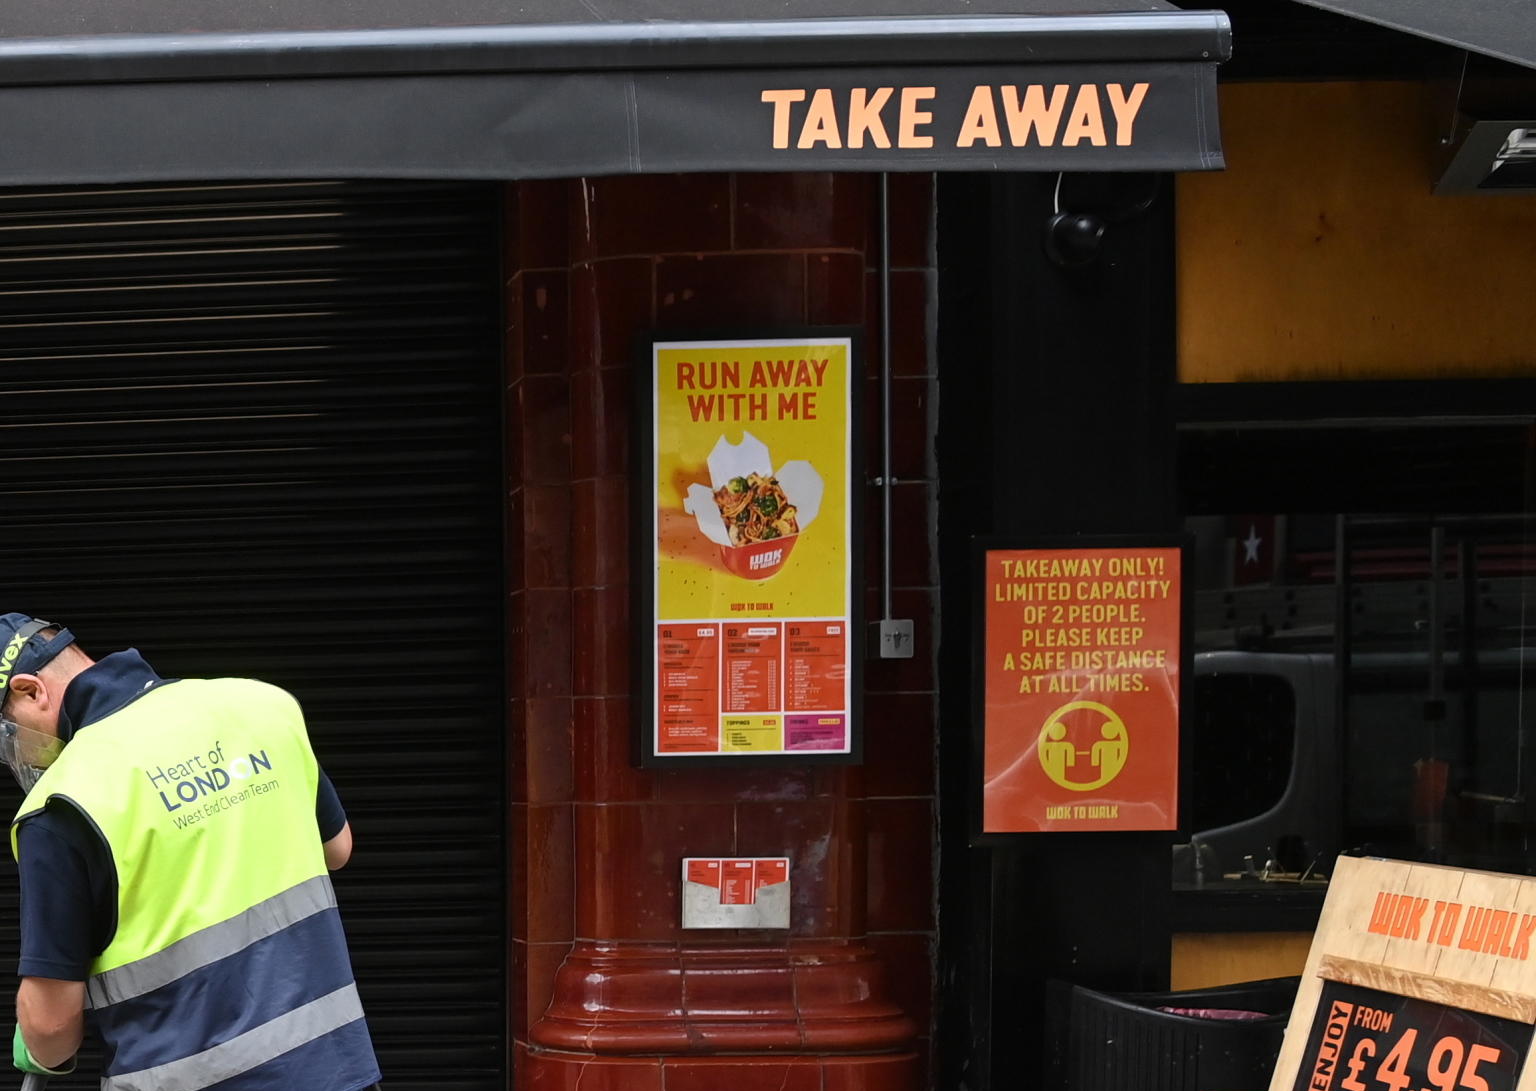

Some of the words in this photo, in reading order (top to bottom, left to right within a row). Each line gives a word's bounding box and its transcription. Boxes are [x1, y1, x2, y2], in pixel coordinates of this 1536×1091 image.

[761, 86, 936, 149] TAKE
[956, 82, 1150, 147] AWAY
[677, 361, 740, 390] RUN
[749, 359, 829, 388] AWAY
[687, 393, 768, 422] WITH
[778, 392, 817, 421] ME
[750, 549, 782, 564] WOK
[1001, 558, 1103, 578] TAKEAWAY
[1109, 557, 1164, 577] ONLY!
[995, 583, 1071, 602] LIMITED
[1076, 580, 1171, 601] CAPACITY
[1024, 606, 1047, 625] OF
[1052, 605, 1064, 624] 2
[1068, 604, 1146, 623] PEOPLE.
[1022, 628, 1091, 648] PLEASE
[1096, 627, 1144, 646] KEEP
[1003, 652, 1015, 671] A
[1019, 651, 1066, 671] SAFE
[1071, 650, 1166, 670] DISTANCE
[1019, 675, 1043, 694] AT
[1048, 674, 1082, 694] ALL
[1087, 673, 1150, 692] TIMES.
[146, 755, 207, 790] Heart
[208, 740, 224, 764] of
[173, 809, 205, 830] West
[203, 800, 220, 817] End
[219, 789, 252, 811] Clean
[249, 779, 280, 797] Team
[1046, 806, 1071, 820] WOK
[1074, 806, 1086, 820] TO
[1088, 805, 1118, 819] WALK
[1368, 891, 1429, 941] WOK
[1427, 900, 1463, 947] TO
[1458, 905, 1536, 961] WALK
[1354, 1006, 1394, 1033] FROM
[1313, 1003, 1349, 1091] ENJOY
